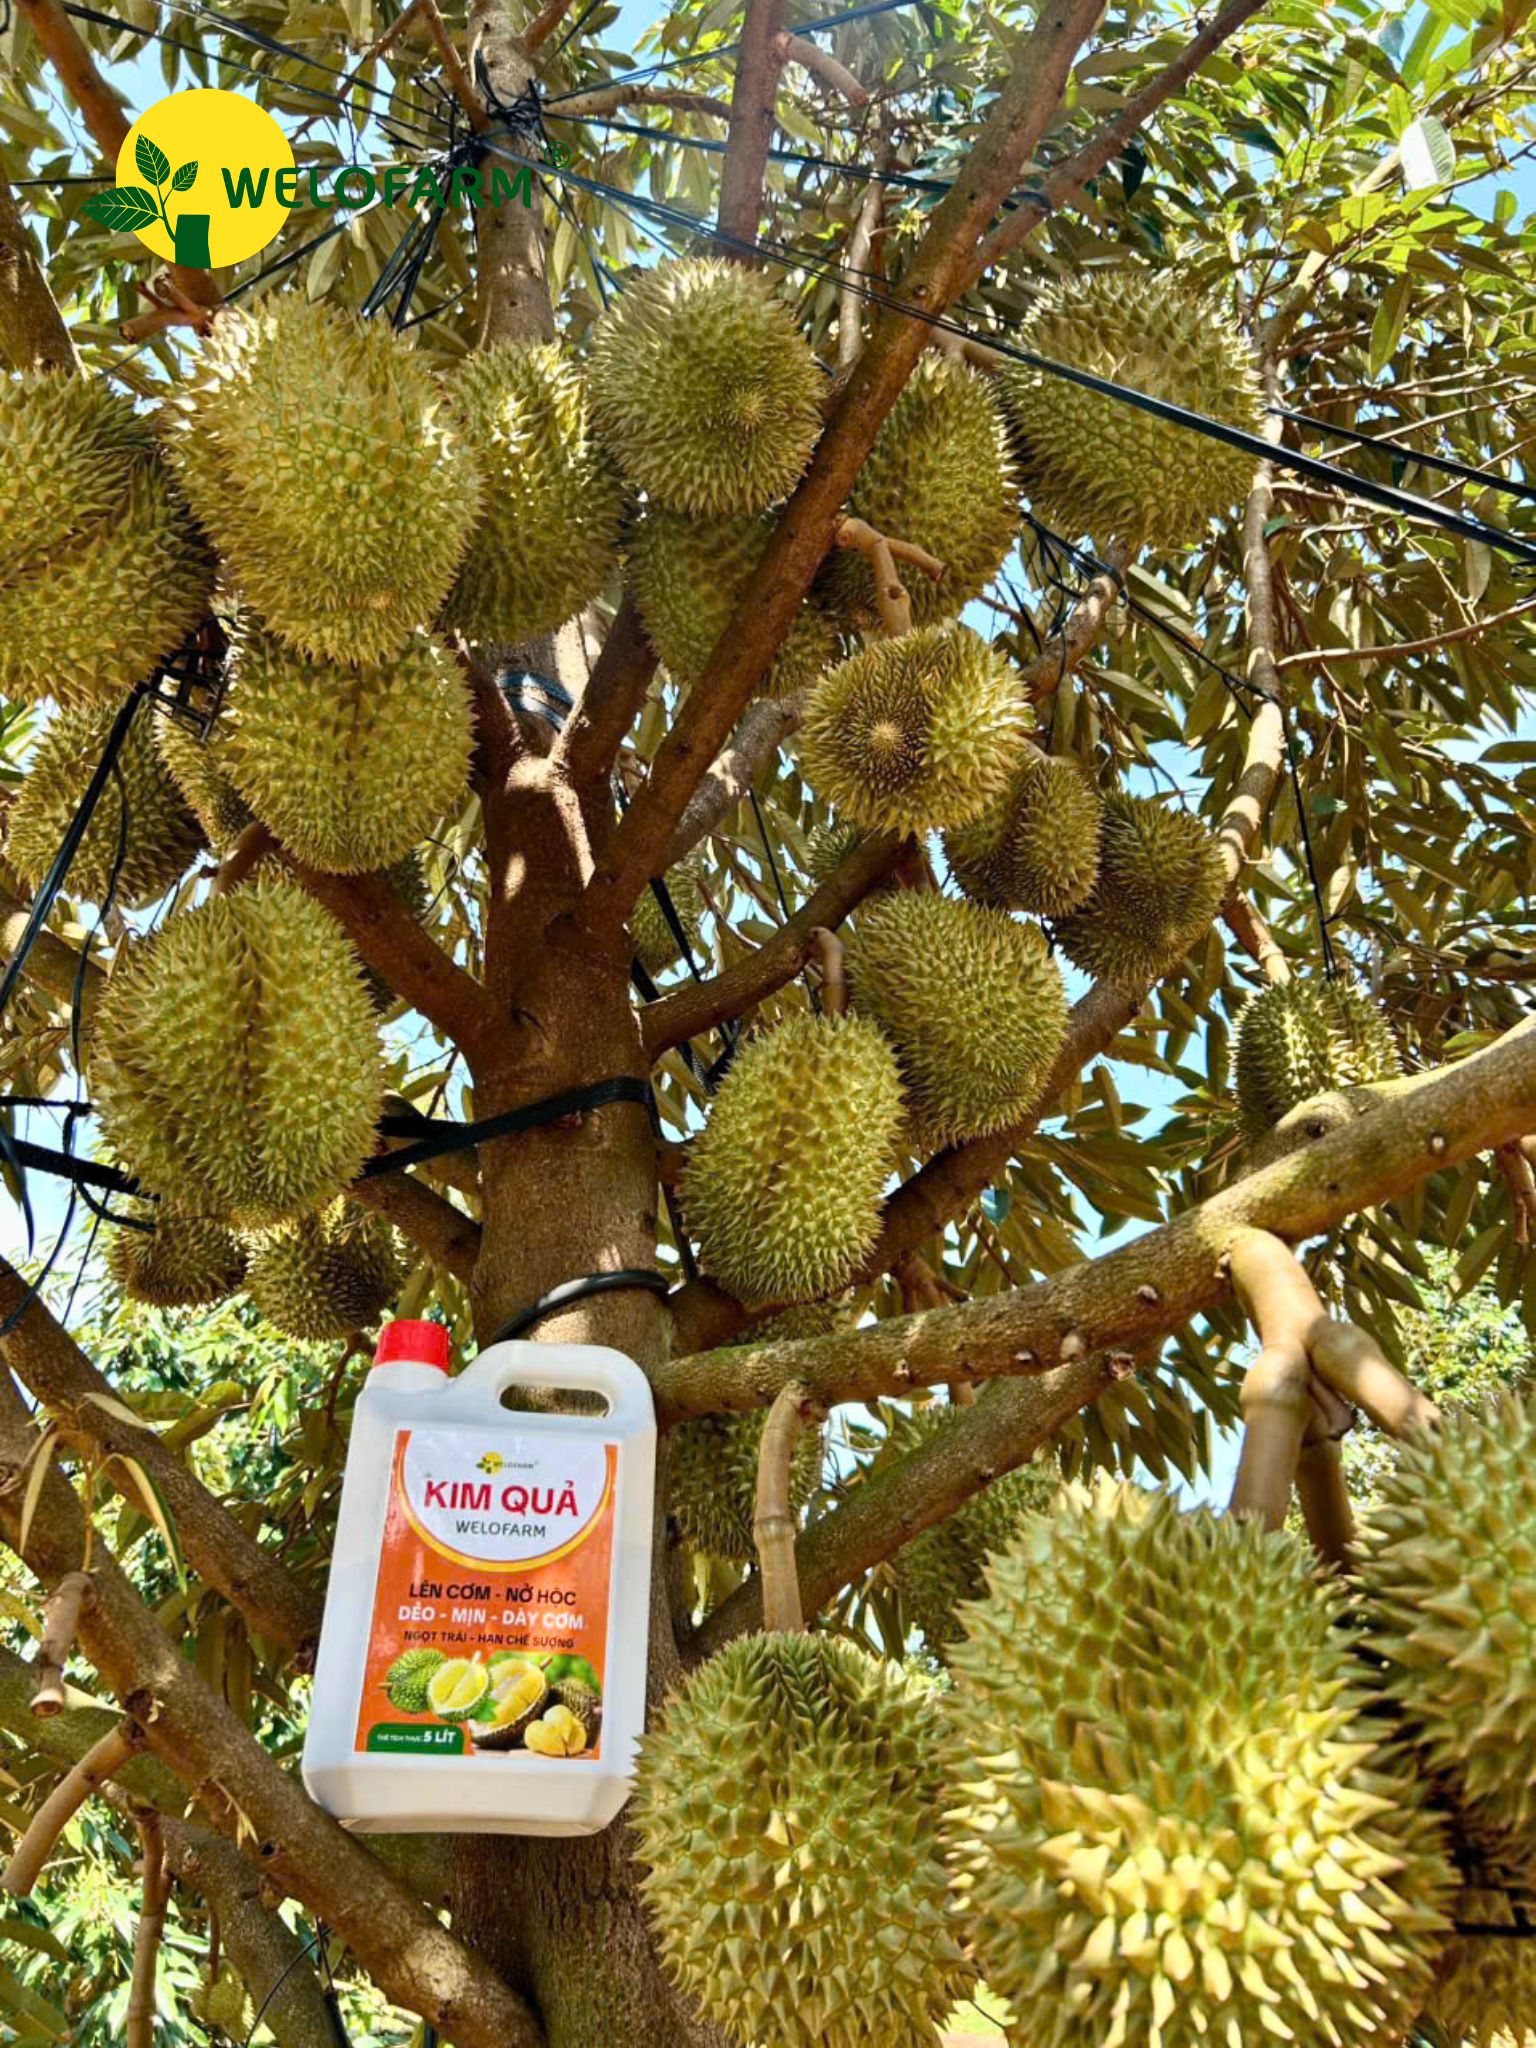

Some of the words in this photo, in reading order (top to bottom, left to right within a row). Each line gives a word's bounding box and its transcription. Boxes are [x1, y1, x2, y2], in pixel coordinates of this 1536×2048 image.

[424, 1480, 492, 1511] KIM
[501, 1479, 579, 1518] QUẢ
[455, 1519, 547, 1537] WELOFARM
[446, 1584, 491, 1600] CƠM
[505, 1582, 534, 1603] NỞ
[398, 1601, 435, 1621] DẺO
[451, 1607, 486, 1627] MỊN
[502, 1608, 539, 1627] DÀY
[542, 1612, 584, 1629] CƠM
[403, 1630, 437, 1643] NGỌT
[440, 1629, 467, 1642] TRÁI
[477, 1633, 504, 1646] HẠN
[506, 1632, 530, 1646] CHẾ
[423, 1730, 432, 1742] 5
[434, 1728, 456, 1743] LÍT
